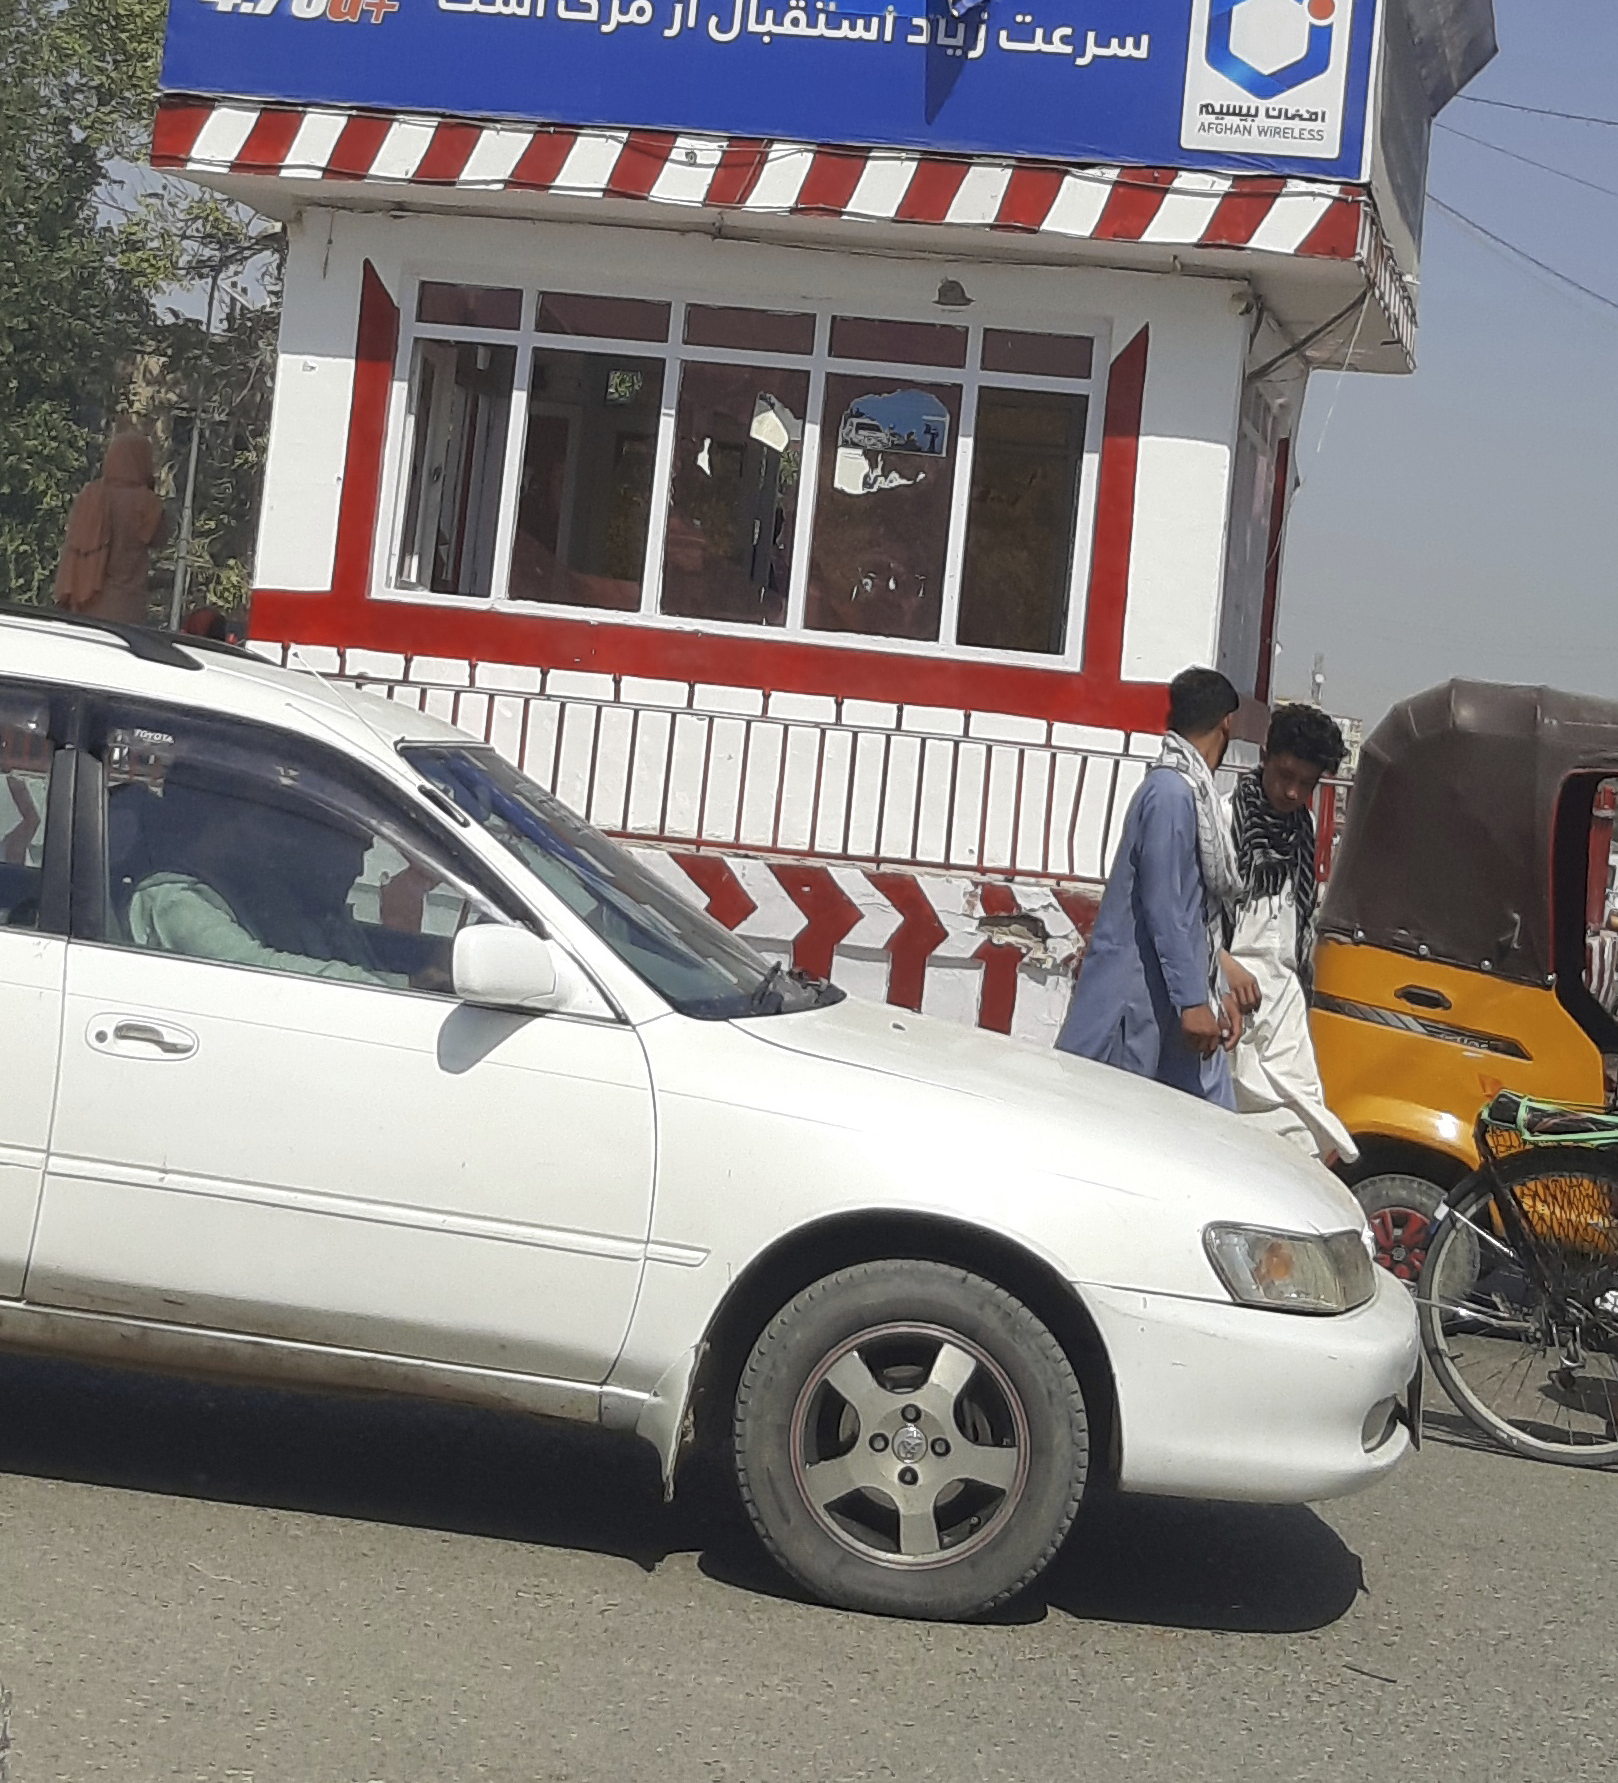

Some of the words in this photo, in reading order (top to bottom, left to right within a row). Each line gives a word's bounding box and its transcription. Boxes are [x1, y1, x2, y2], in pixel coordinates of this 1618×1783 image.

[905, 10, 991, 61] زیاد
[997, 12, 1152, 67] سرعت
[1196, 120, 1253, 138] AFGHAN
[133, 728, 175, 744] TOYOTA
